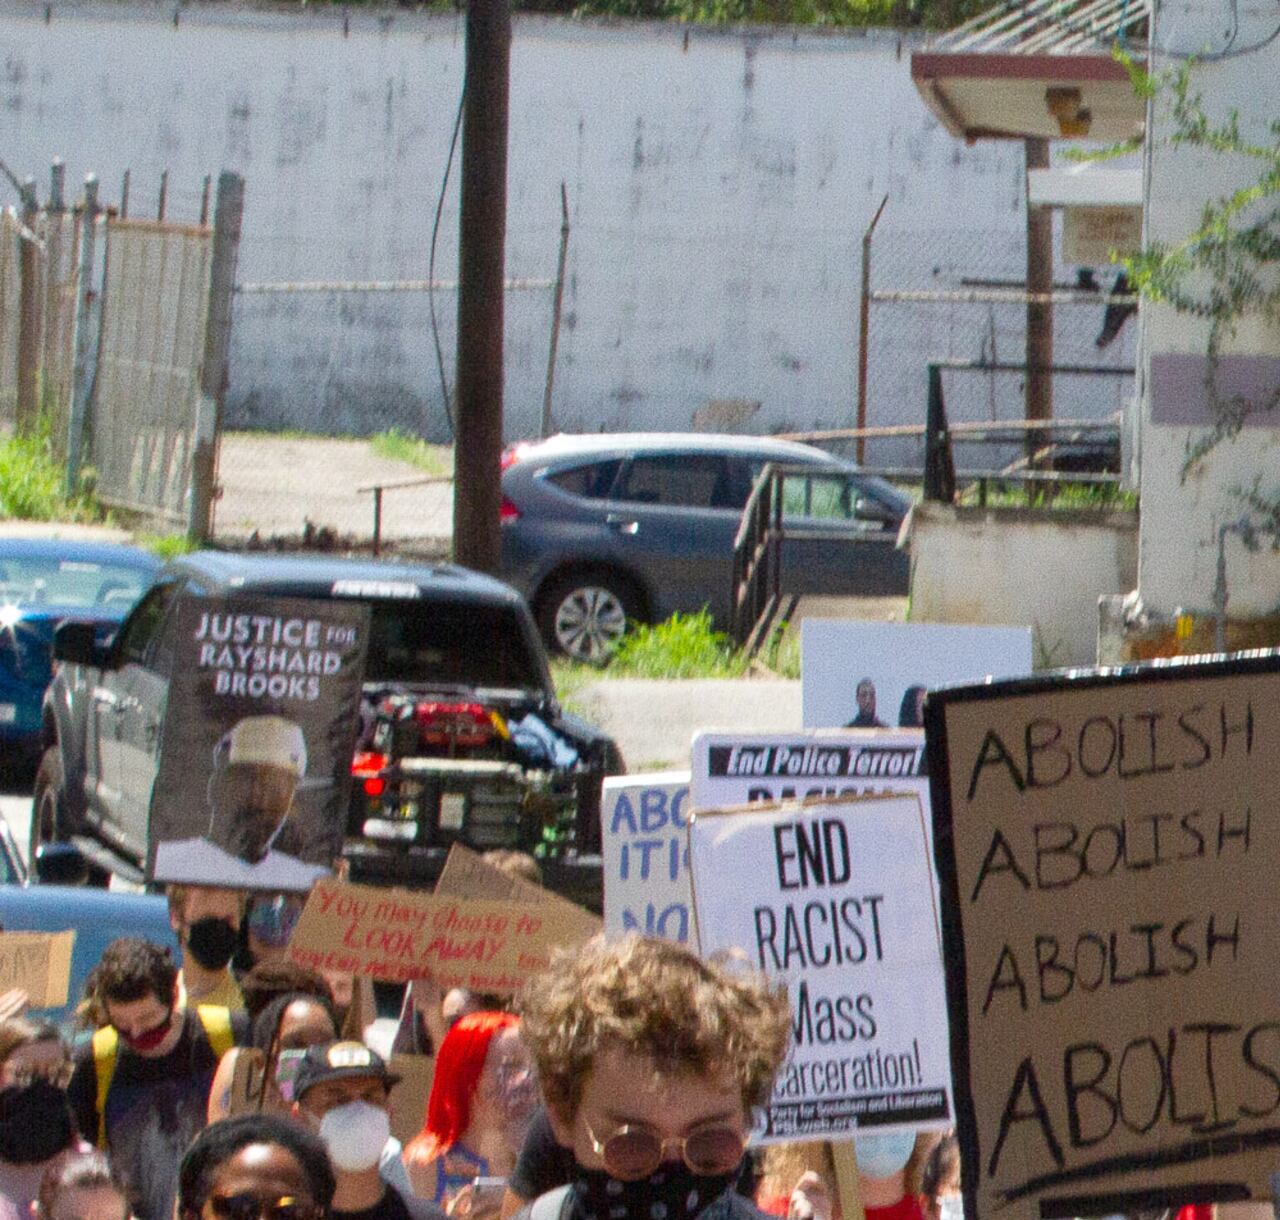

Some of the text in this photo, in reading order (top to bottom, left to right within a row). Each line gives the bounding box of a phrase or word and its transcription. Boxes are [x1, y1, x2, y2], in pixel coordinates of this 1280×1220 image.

[196, 612, 322, 648] JUSTICE
[200, 643, 342, 676] RAYSHARD
[214, 671, 321, 701] BROOKS
[726, 746, 925, 776] End Police Terror!
[967, 704, 1256, 800] ABOLISH
[610, 788, 691, 834] ABO
[619, 837, 690, 881] ITI
[773, 818, 852, 891] END
[971, 808, 1252, 902] ABOLISH
[621, 902, 690, 944] NO
[753, 896, 885, 971] RACIST
[983, 914, 1240, 1015] ABOLISH
[773, 1037, 923, 1099] carceration!
